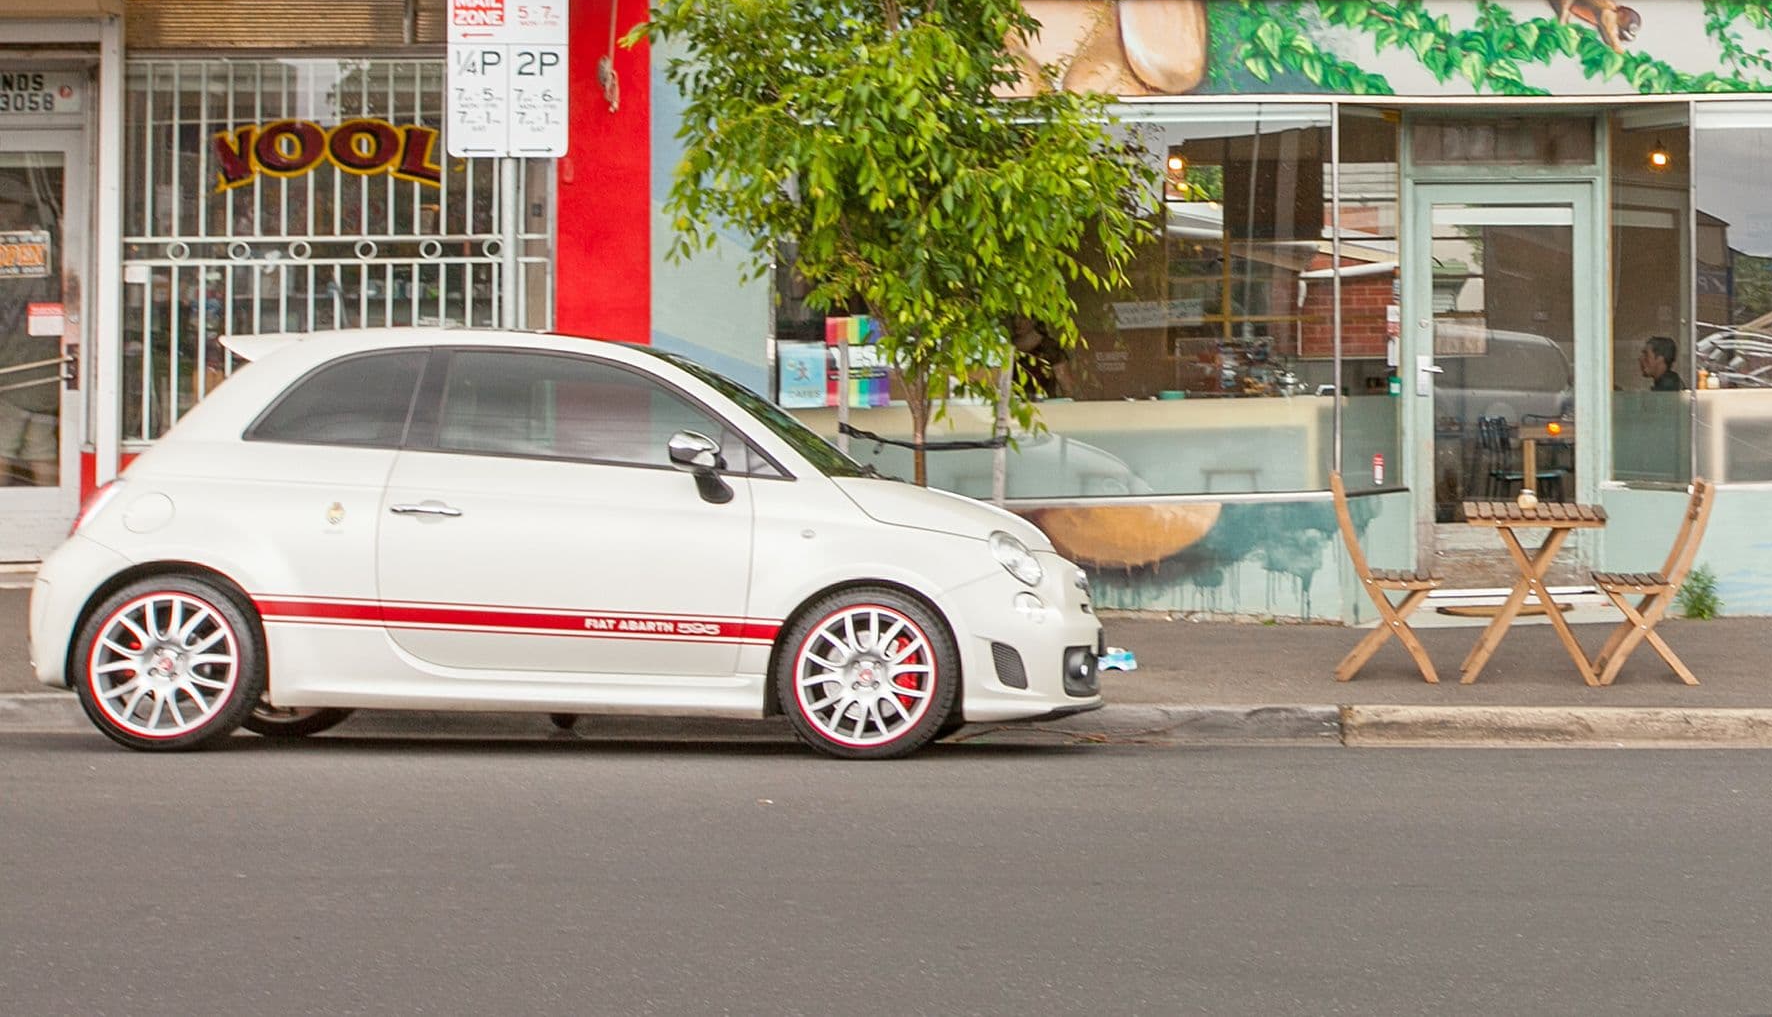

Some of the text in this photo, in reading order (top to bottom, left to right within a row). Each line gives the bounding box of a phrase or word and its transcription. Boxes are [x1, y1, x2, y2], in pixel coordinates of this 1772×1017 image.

[456, 10, 503, 24] ZONE
[517, 51, 560, 76] 2P
[0, 93, 54, 111] 3058
[584, 618, 617, 631] FIAT
[618, 620, 674, 634] ABARTH
